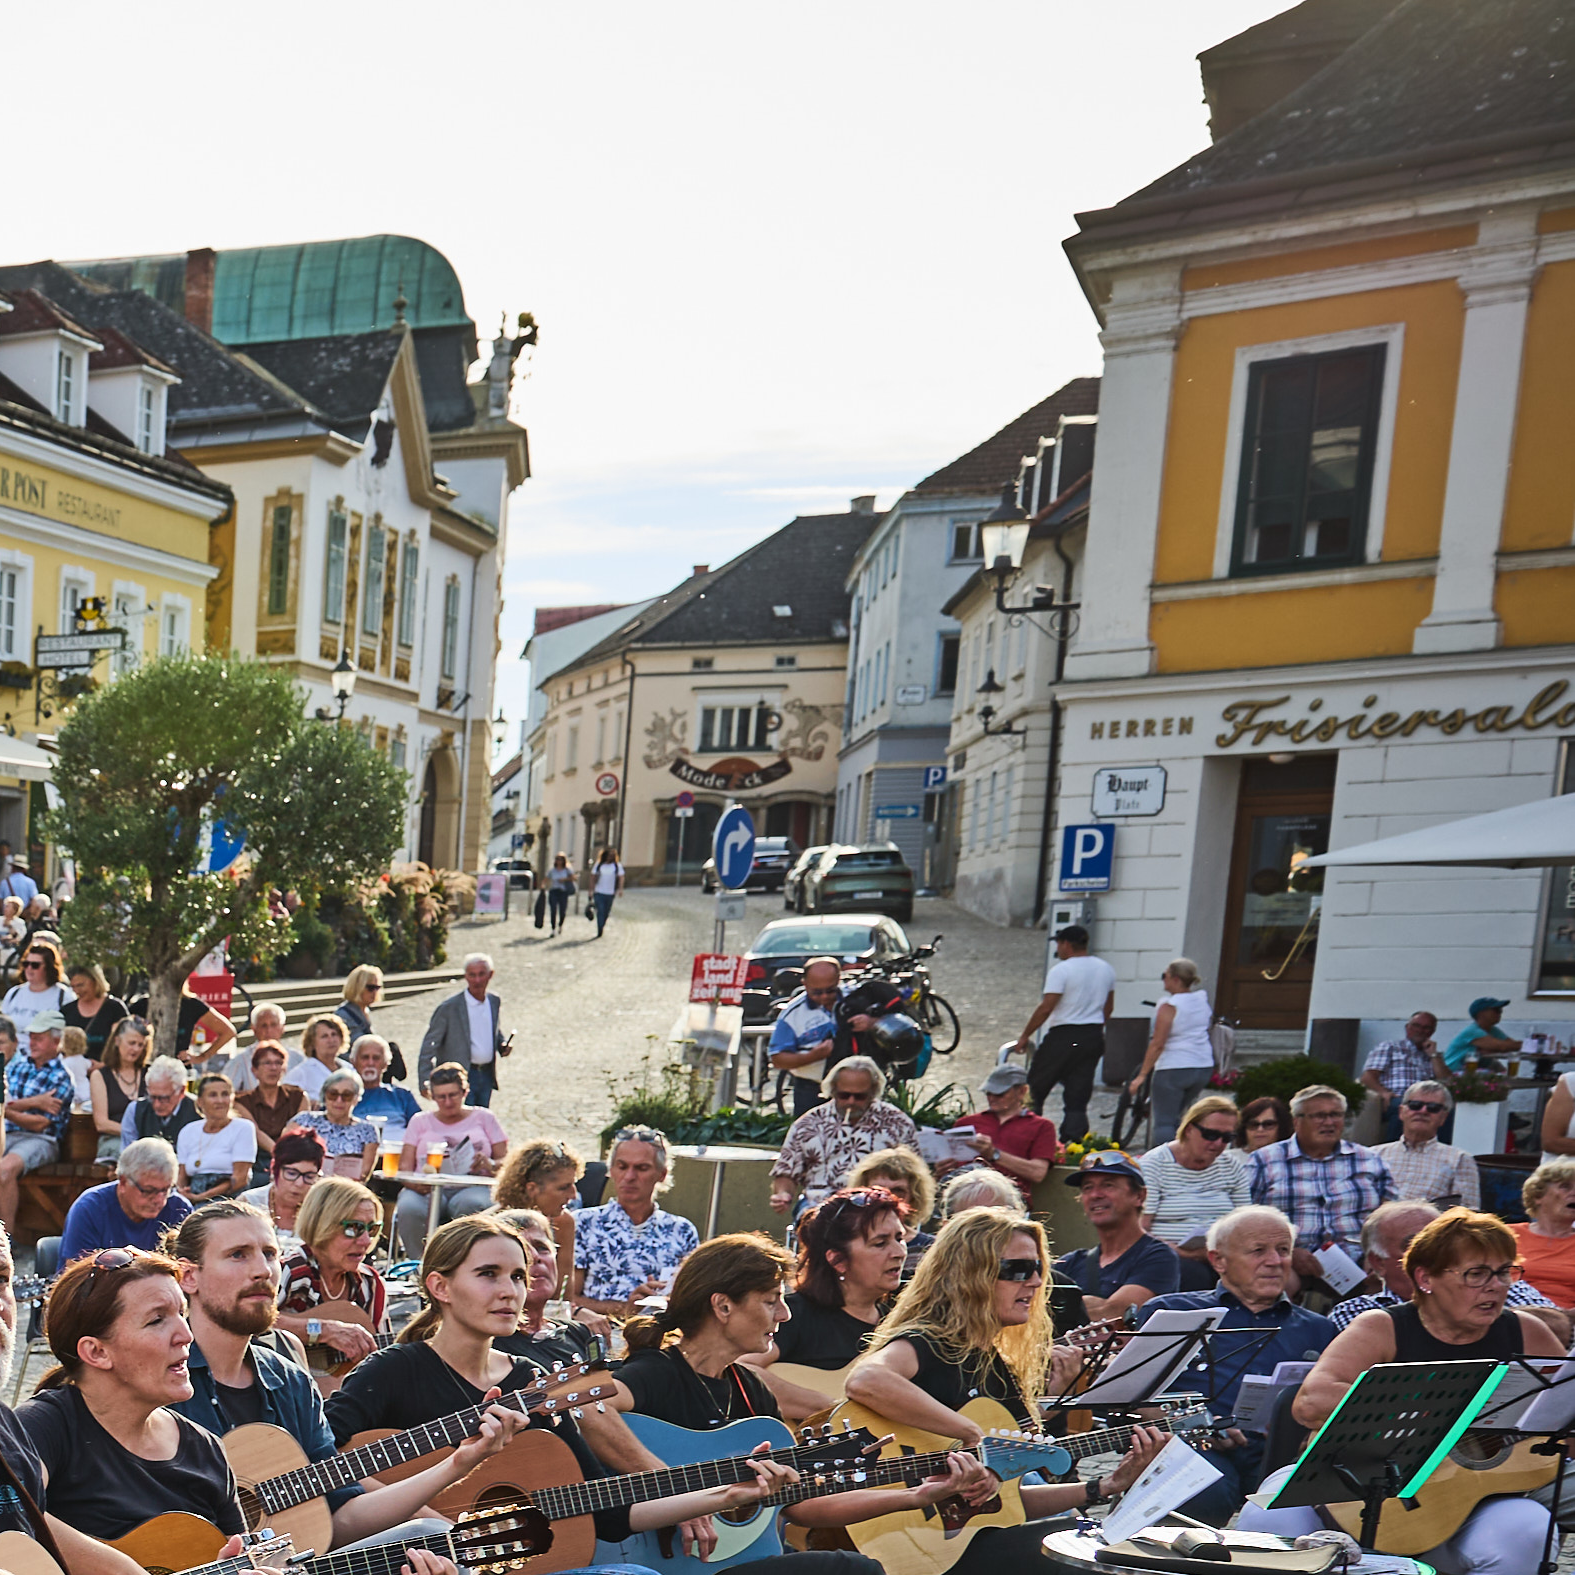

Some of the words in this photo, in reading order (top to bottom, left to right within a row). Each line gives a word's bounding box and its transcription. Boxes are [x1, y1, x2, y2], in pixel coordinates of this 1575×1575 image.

[13, 471, 48, 510] POST
[57, 490, 122, 527] RESTAURANT
[39, 634, 119, 651] RESTAURANT
[43, 651, 86, 667] HOTEL
[1090, 716, 1194, 741] HERREN
[677, 764, 726, 788] Mode
[928, 768, 943, 787] P
[1072, 828, 1104, 875] P
[703, 956, 738, 971] stadt
[704, 970, 735, 984] land
